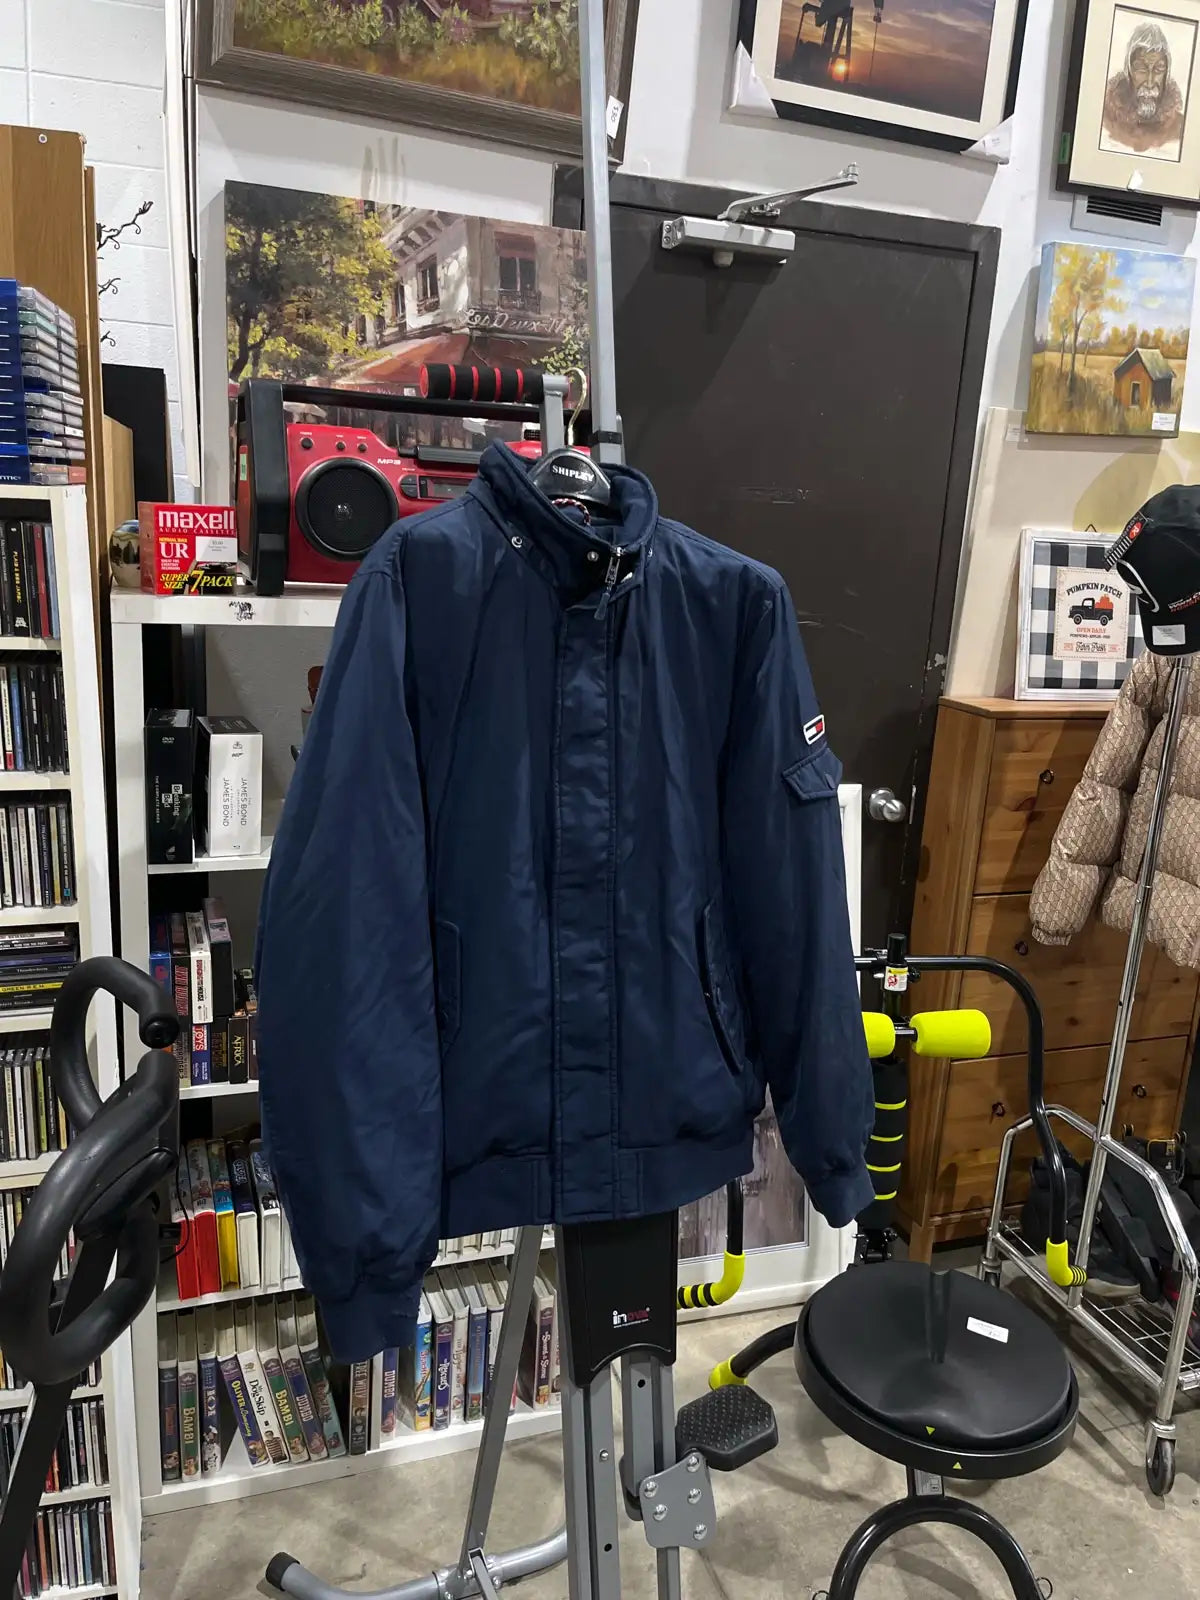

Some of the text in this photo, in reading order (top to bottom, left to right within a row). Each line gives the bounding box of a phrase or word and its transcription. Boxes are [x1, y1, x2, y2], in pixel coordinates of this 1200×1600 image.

[552, 464, 594, 482] SHIPLEY
[158, 510, 234, 530] maxell
[160, 542, 189, 558] UR
[160, 573, 190, 582] SUPER
[190, 570, 234, 592] 7 PACK
[1066, 583, 1123, 598] PUMPKIN PATCH
[162, 793, 172, 808] Bad
[172, 784, 182, 816] Breaking
[195, 1027, 204, 1051] TOYS
[232, 1035, 242, 1066] AFRICA
[232, 1380, 245, 1407] OLIVER
[355, 1379, 367, 1398] WILLY
[384, 1370, 395, 1398] DUMBO
[249, 1379, 266, 1416] Dog Skip
[276, 1389, 293, 1425] BAMBI
[296, 1395, 313, 1422] DUMBO
[183, 1406, 195, 1444] BAMBI
